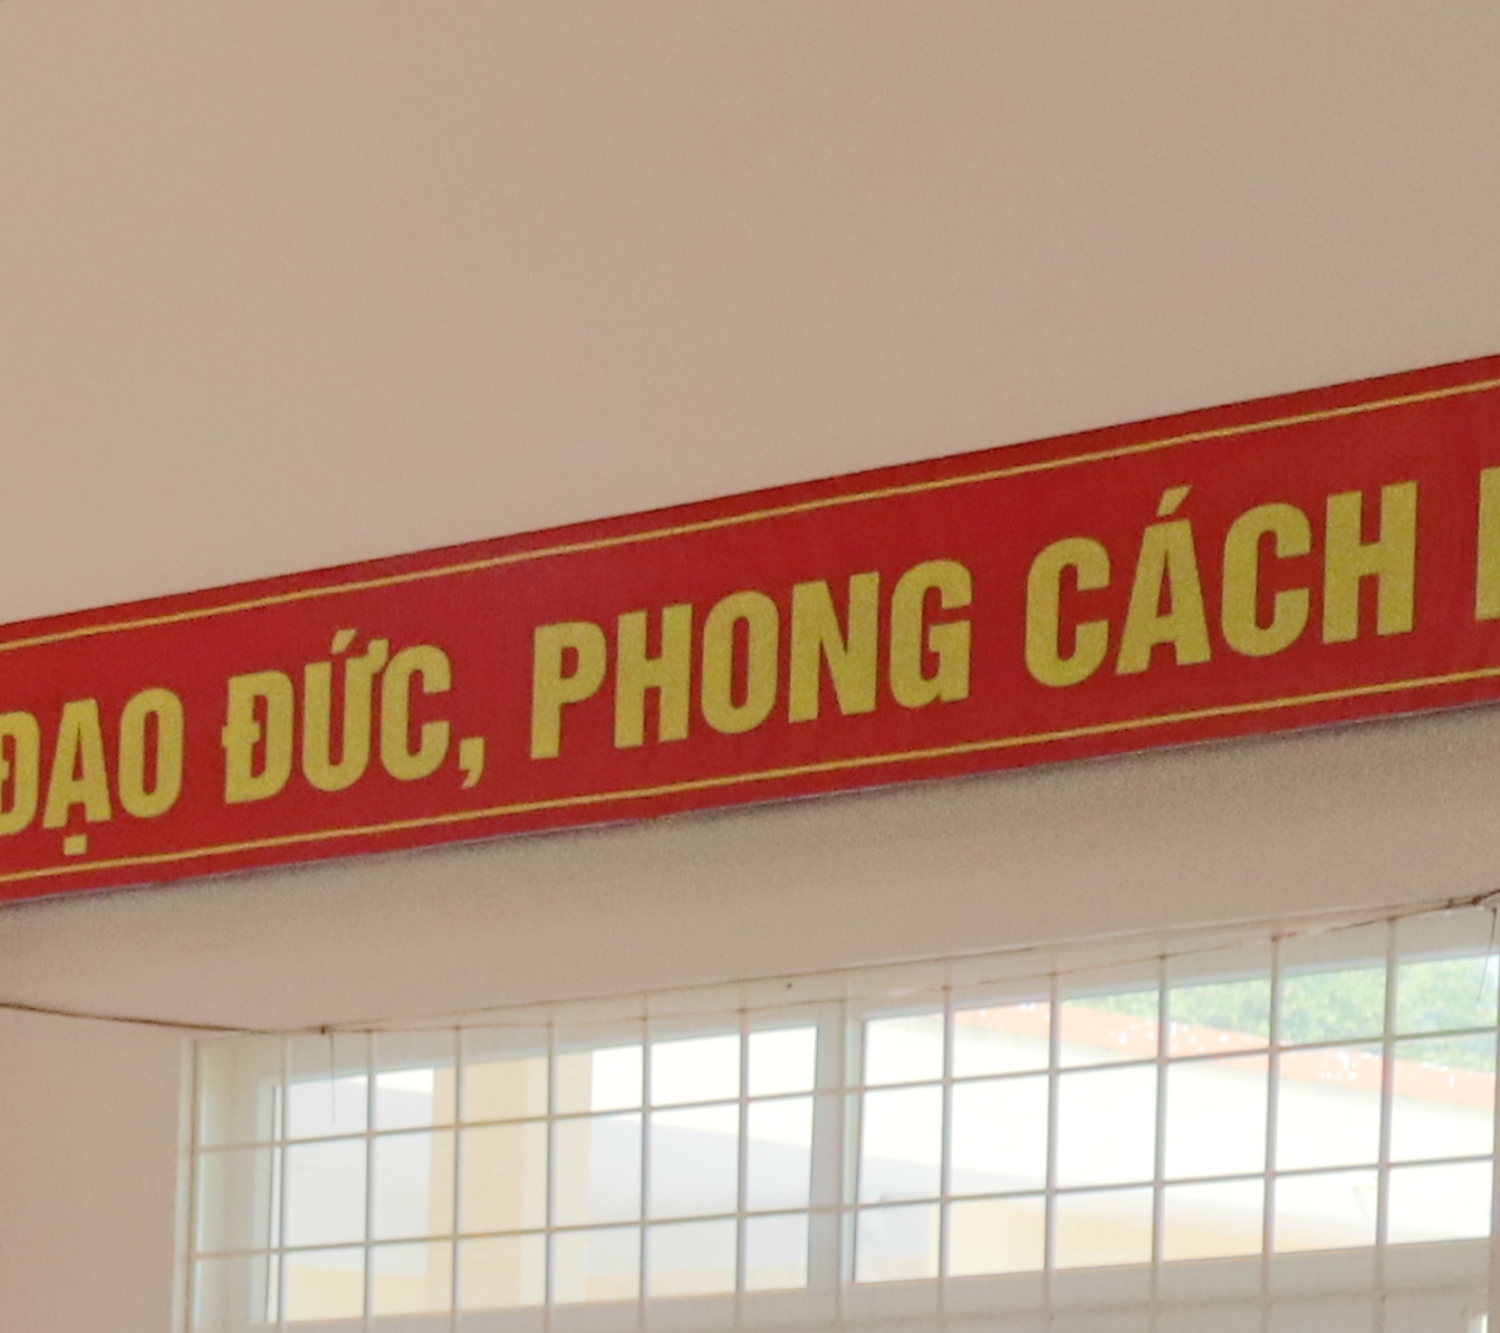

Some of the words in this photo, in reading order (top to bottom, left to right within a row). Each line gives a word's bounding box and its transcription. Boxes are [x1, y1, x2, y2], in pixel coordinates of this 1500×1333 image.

[222, 629, 485, 805] ĐỨC,
[530, 559, 972, 761] PHONG
[1024, 481, 1418, 688] CÁCH
